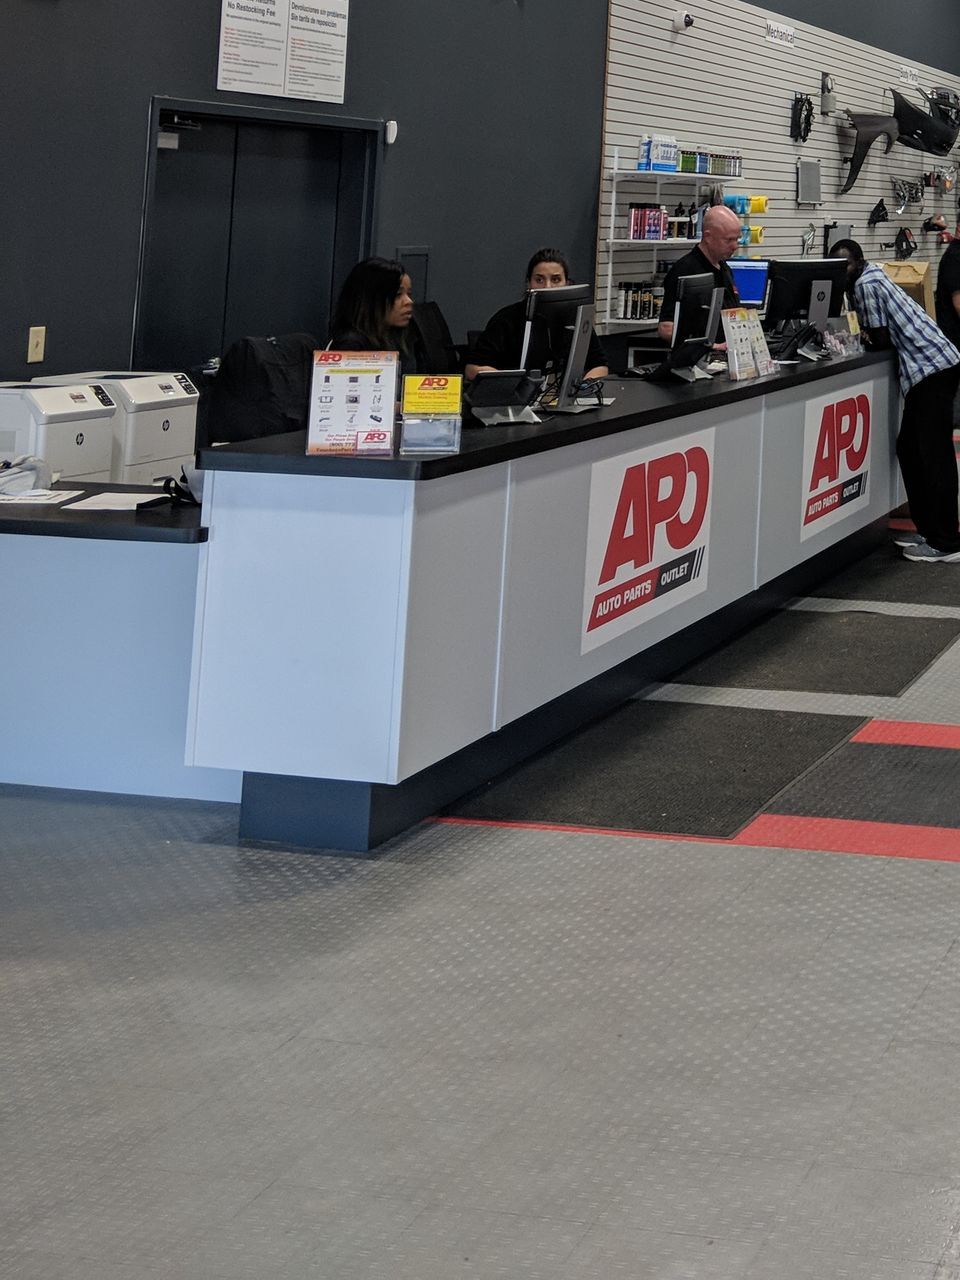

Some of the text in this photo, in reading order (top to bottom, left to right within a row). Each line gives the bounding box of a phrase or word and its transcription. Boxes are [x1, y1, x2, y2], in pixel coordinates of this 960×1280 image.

[227, 1, 276, 17] No Restocking Fee
[766, 23, 795, 43] Mechanical
[318, 353, 342, 362] APO
[420, 377, 448, 387] APO
[809, 394, 871, 493] APO
[808, 481, 859, 517] AUTO PARTS OUTLET
[598, 446, 710, 587] APO
[596, 562, 689, 619] AUTO PARTS OUTLET
